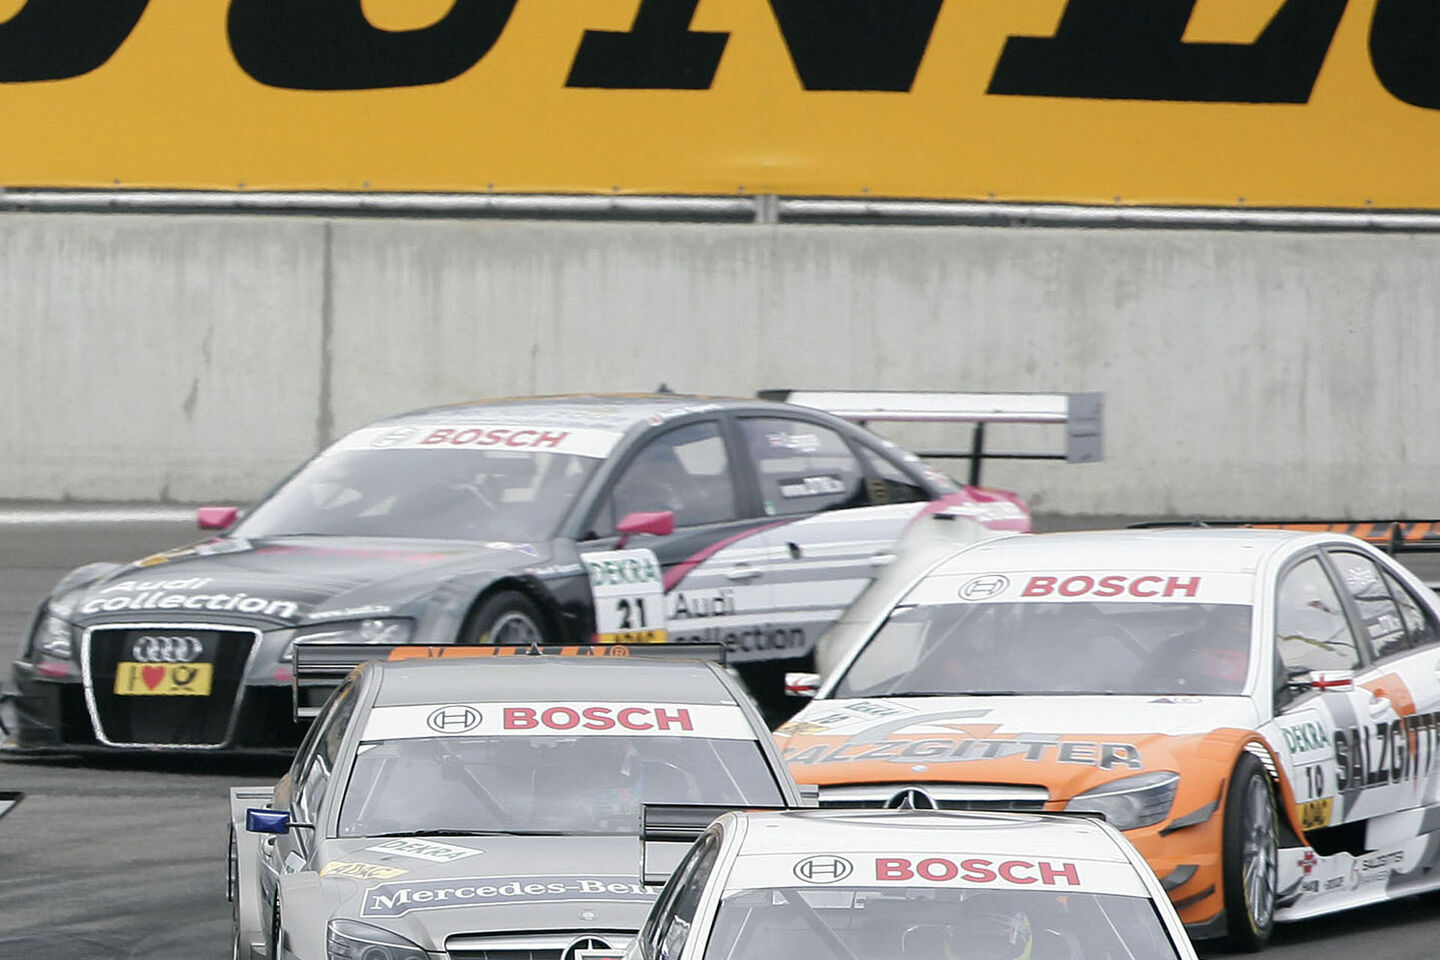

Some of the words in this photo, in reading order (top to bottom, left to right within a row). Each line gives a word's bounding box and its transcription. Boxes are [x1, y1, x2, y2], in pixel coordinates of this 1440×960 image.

[421, 428, 569, 449] BOSCH
[102, 577, 214, 593] Audi
[1020, 576, 1202, 598] BOSCH
[80, 591, 300, 619] collection
[617, 598, 647, 629] 21
[672, 588, 735, 619] Audi
[503, 706, 694, 732] BOSCH
[1281, 721, 1330, 754] DEKRA
[381, 840, 465, 860] DEKRA
[875, 857, 1082, 887] BOSCH
[369, 878, 662, 911] Mercedes-Ben
